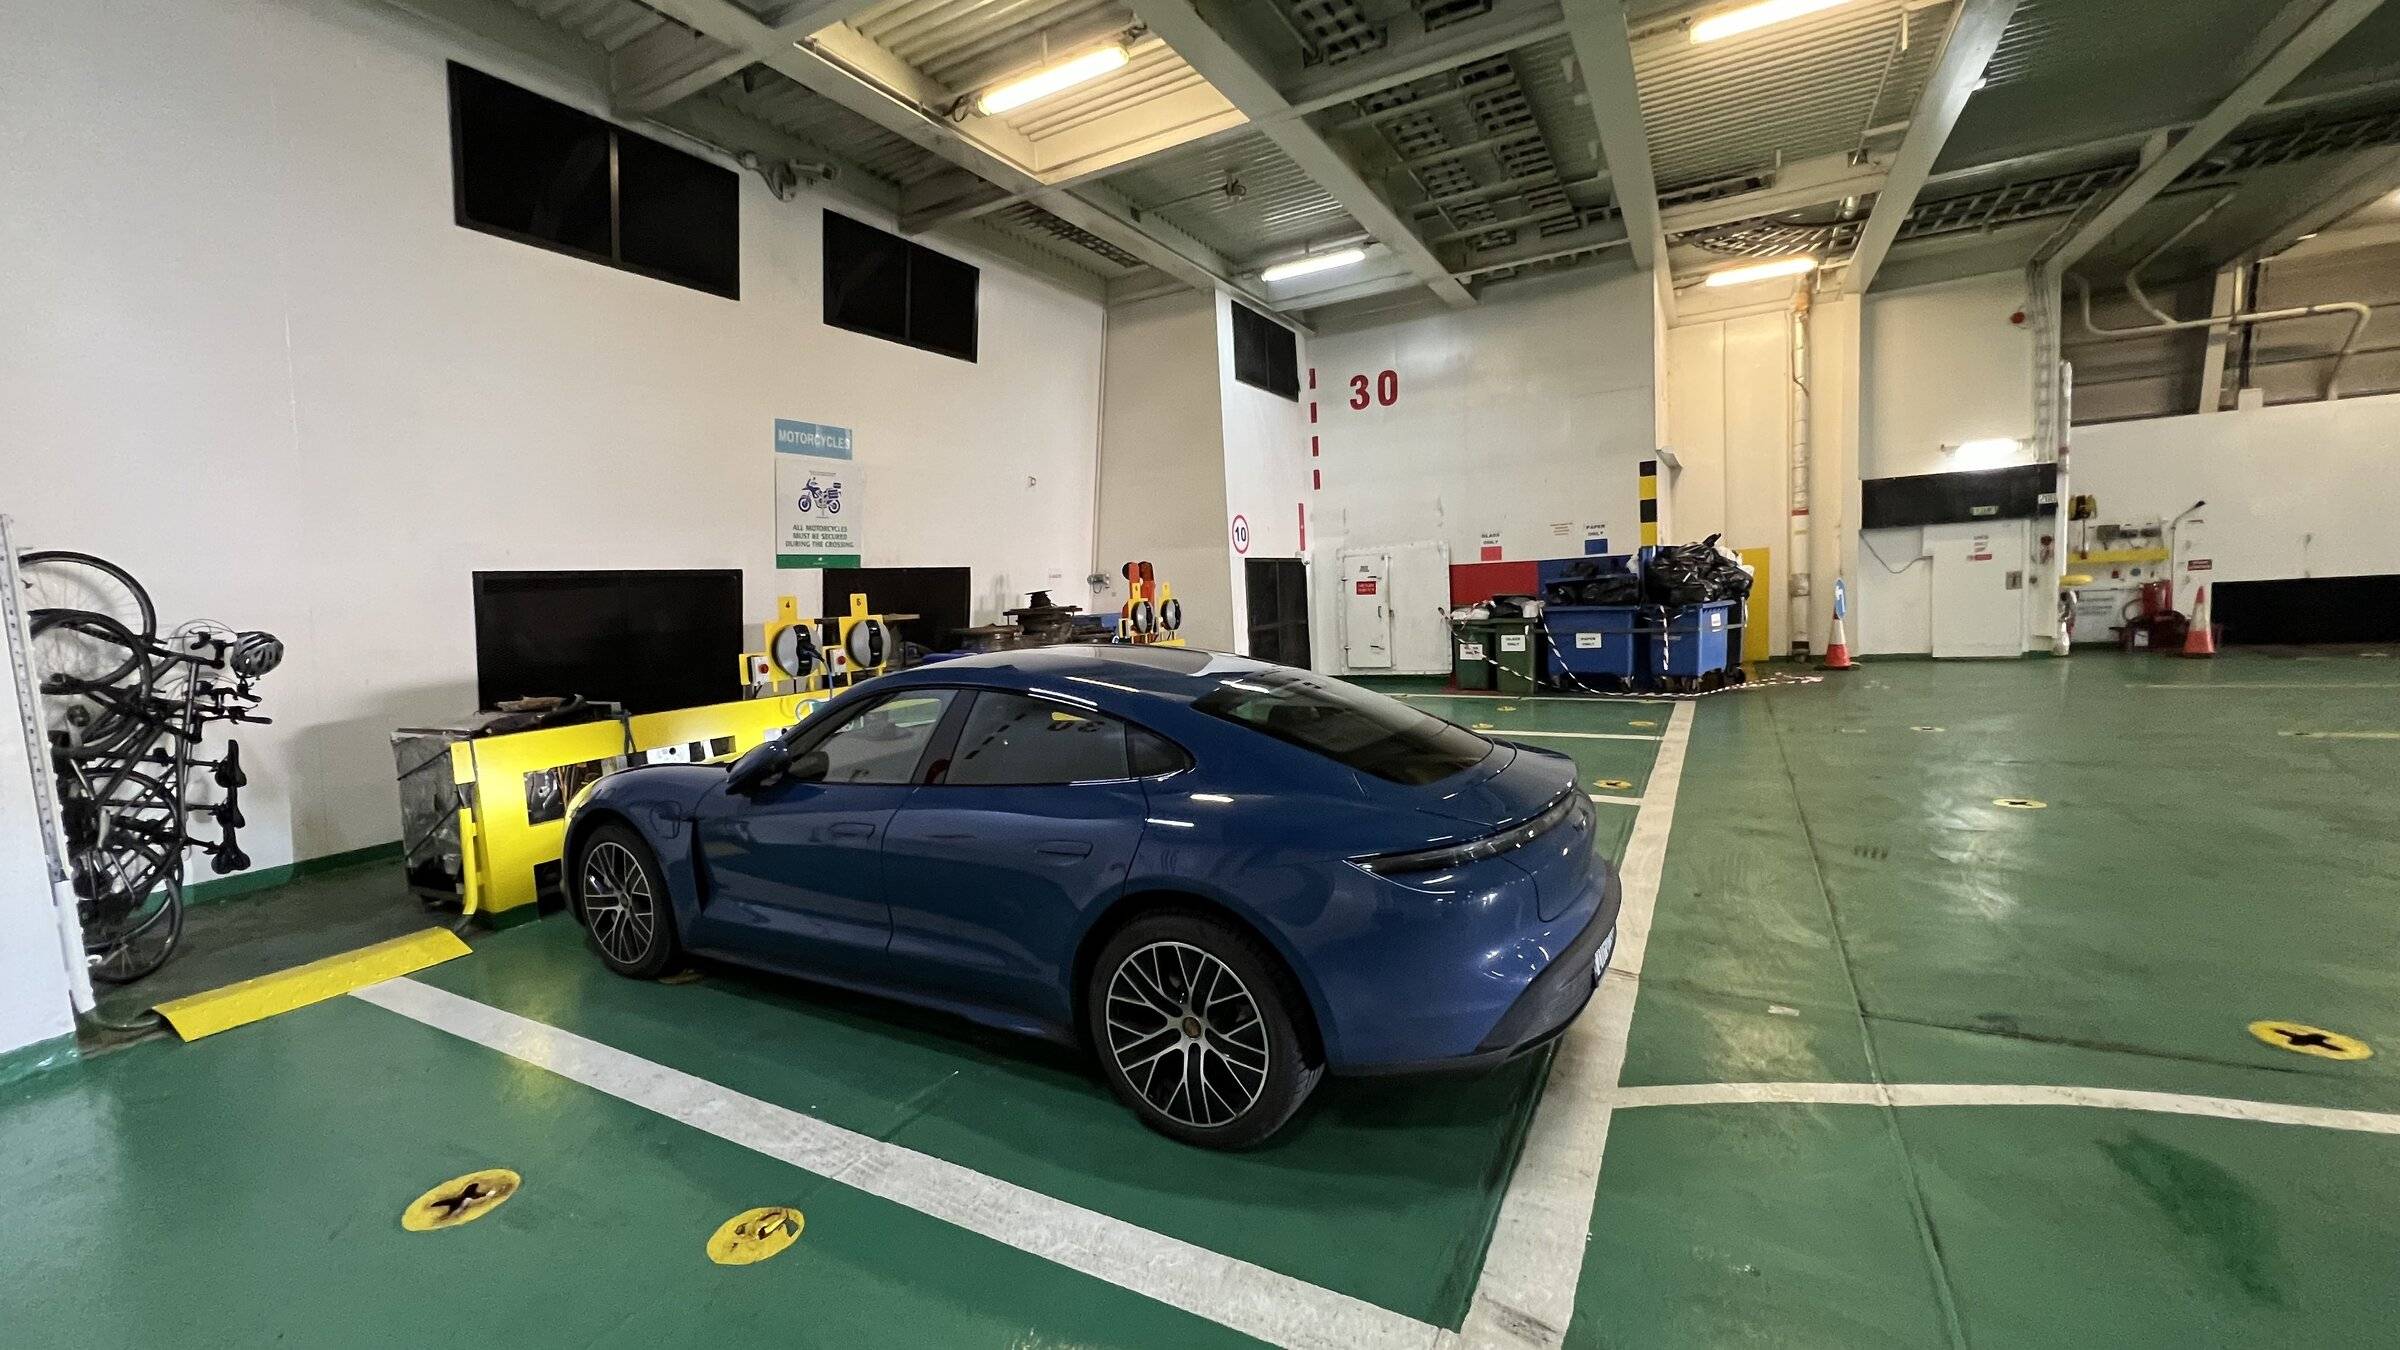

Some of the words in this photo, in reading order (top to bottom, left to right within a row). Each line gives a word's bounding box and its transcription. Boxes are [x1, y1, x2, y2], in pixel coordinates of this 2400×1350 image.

[1350, 370, 1398, 410] 30
[778, 429, 850, 450] MOTORCYCLES
[1235, 526, 1247, 542] 10
[785, 600, 791, 608] 4
